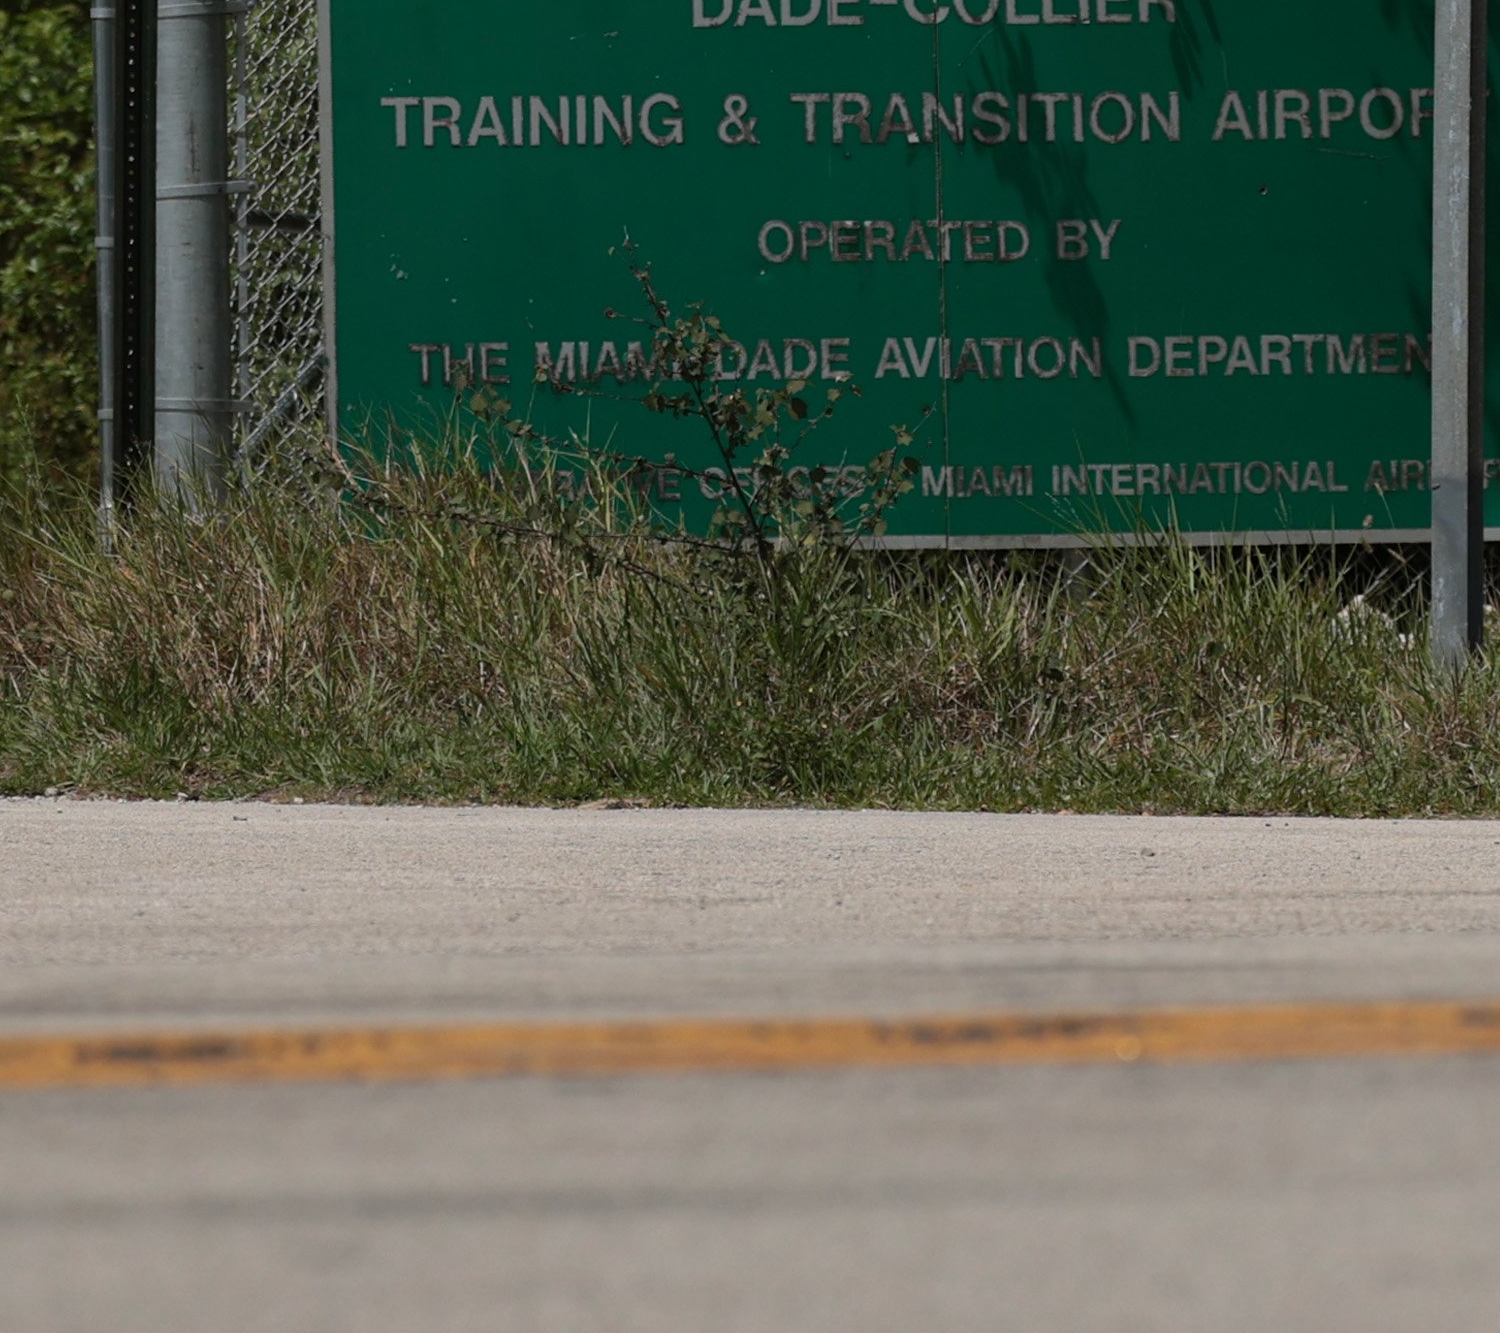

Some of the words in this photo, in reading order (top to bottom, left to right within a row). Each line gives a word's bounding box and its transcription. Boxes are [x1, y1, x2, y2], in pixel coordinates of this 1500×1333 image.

[380, 92, 685, 147] TRAINING
[716, 93, 761, 145] &
[790, 90, 1181, 145] TRANSITION
[1212, 87, 1435, 141] AIRPOR
[757, 218, 1030, 264] OPERATED
[1055, 218, 1122, 261] BY
[409, 342, 511, 385] THE
[874, 334, 1101, 381] AVIATION
[1127, 333, 1433, 378] DEPARTMEN
[920, 464, 1034, 498] MIAMI
[1051, 460, 1348, 498] INTERNATIONAL
